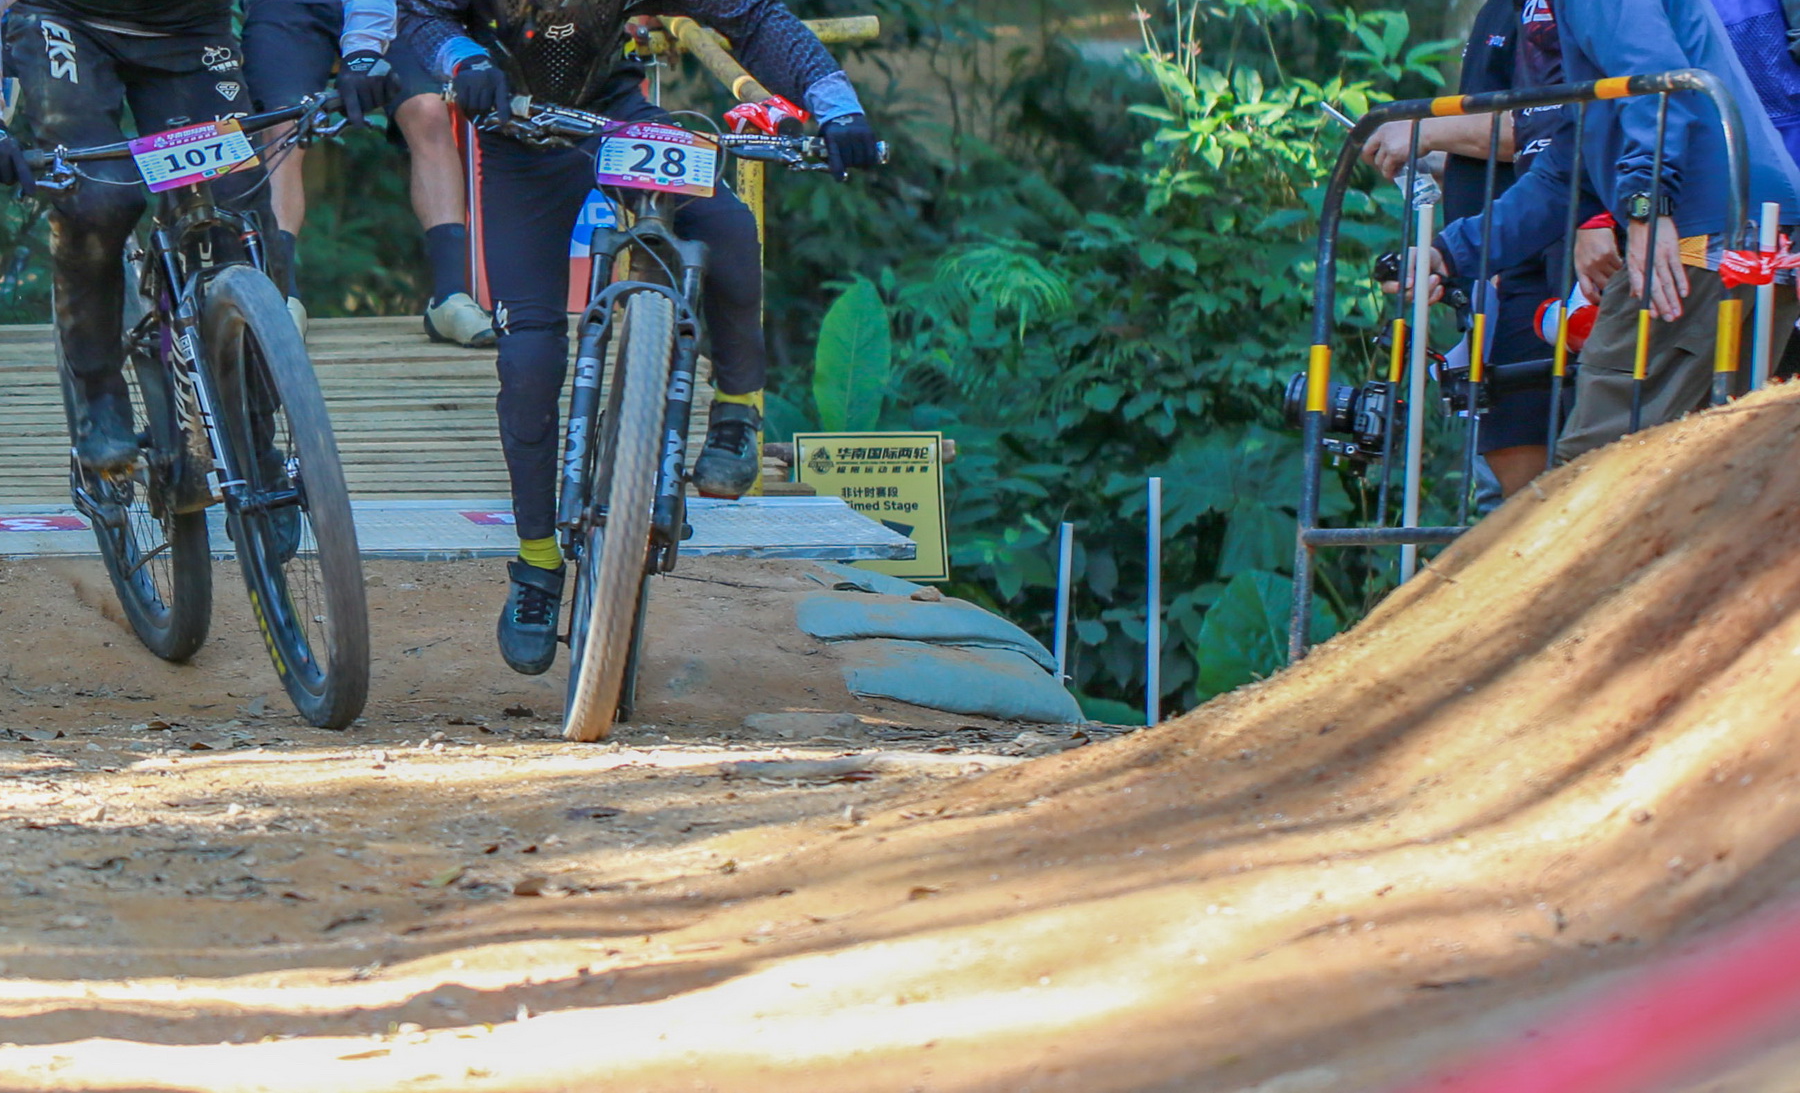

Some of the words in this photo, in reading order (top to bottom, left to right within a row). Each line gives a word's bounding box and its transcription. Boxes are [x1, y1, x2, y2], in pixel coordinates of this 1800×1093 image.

[41, 20, 78, 84] EKS
[164, 142, 224, 173] 107
[629, 143, 686, 177] 28
[563, 416, 588, 484] FOX
[661, 429, 686, 496] FOX
[836, 447, 929, 460] 华南国际两轮
[841, 487, 899, 499] 非计时赛段
[884, 501, 919, 514] Stage
